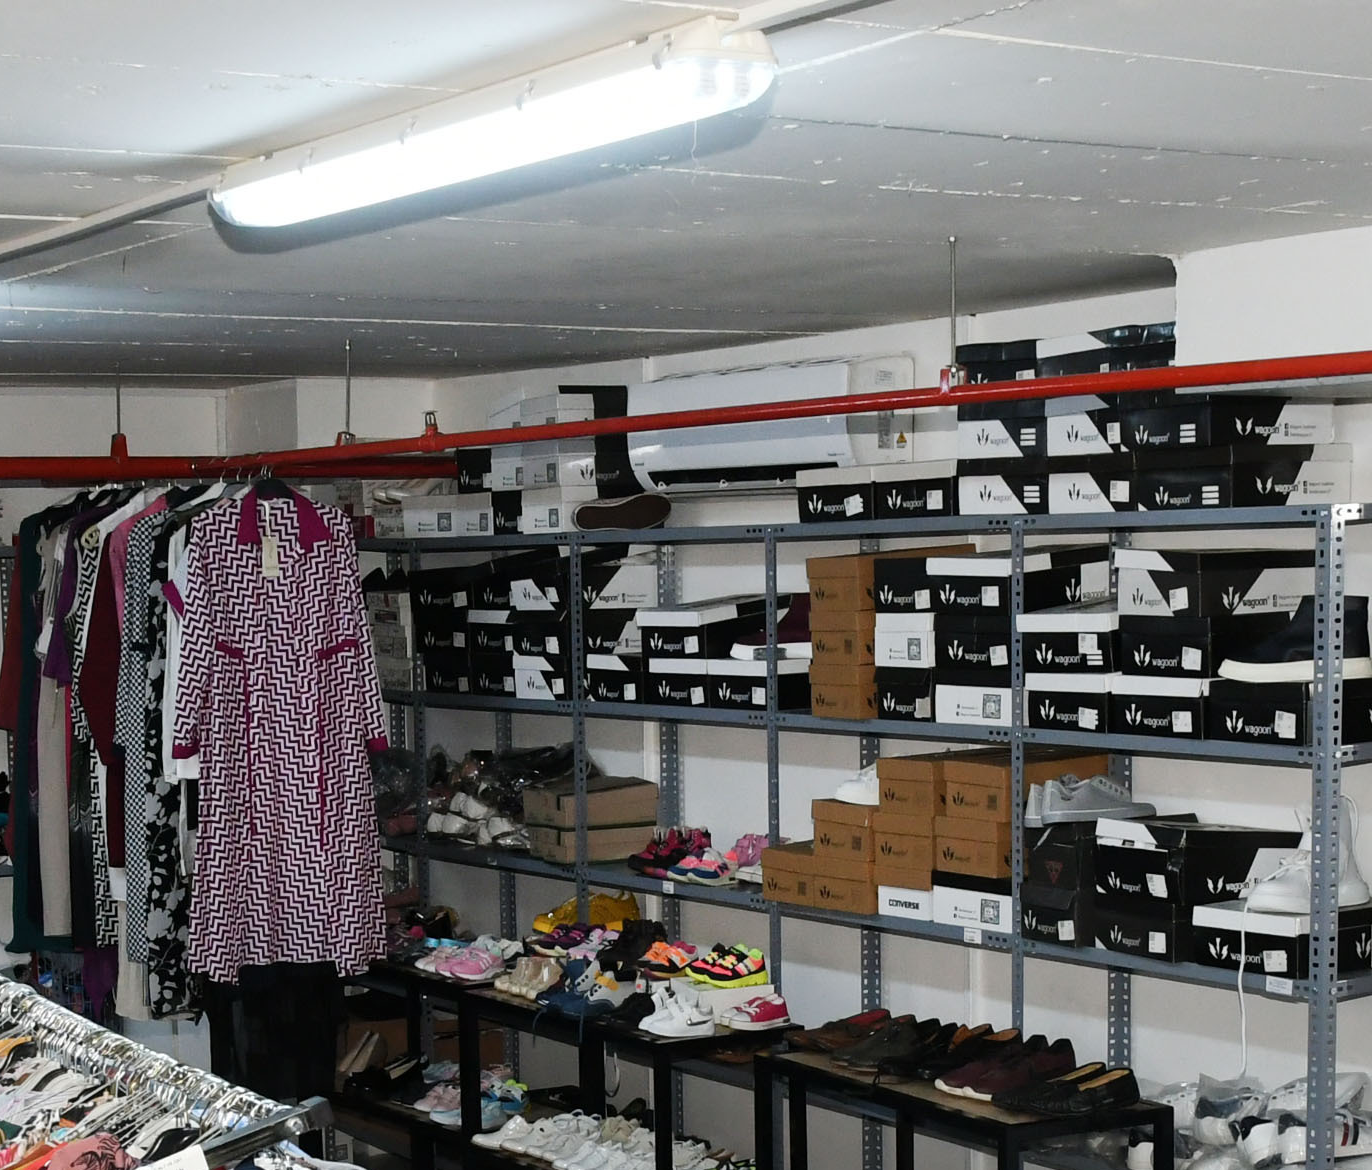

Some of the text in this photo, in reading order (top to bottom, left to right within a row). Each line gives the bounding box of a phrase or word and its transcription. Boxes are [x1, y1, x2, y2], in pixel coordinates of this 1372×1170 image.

[1054, 654, 1080, 666] wagoon
[1152, 656, 1178, 668] wagoon
[1143, 715, 1169, 728] wagoon
[1245, 723, 1272, 736] wagoon
[888, 899, 920, 910] CONVERSE
[1230, 952, 1261, 964] waoon
